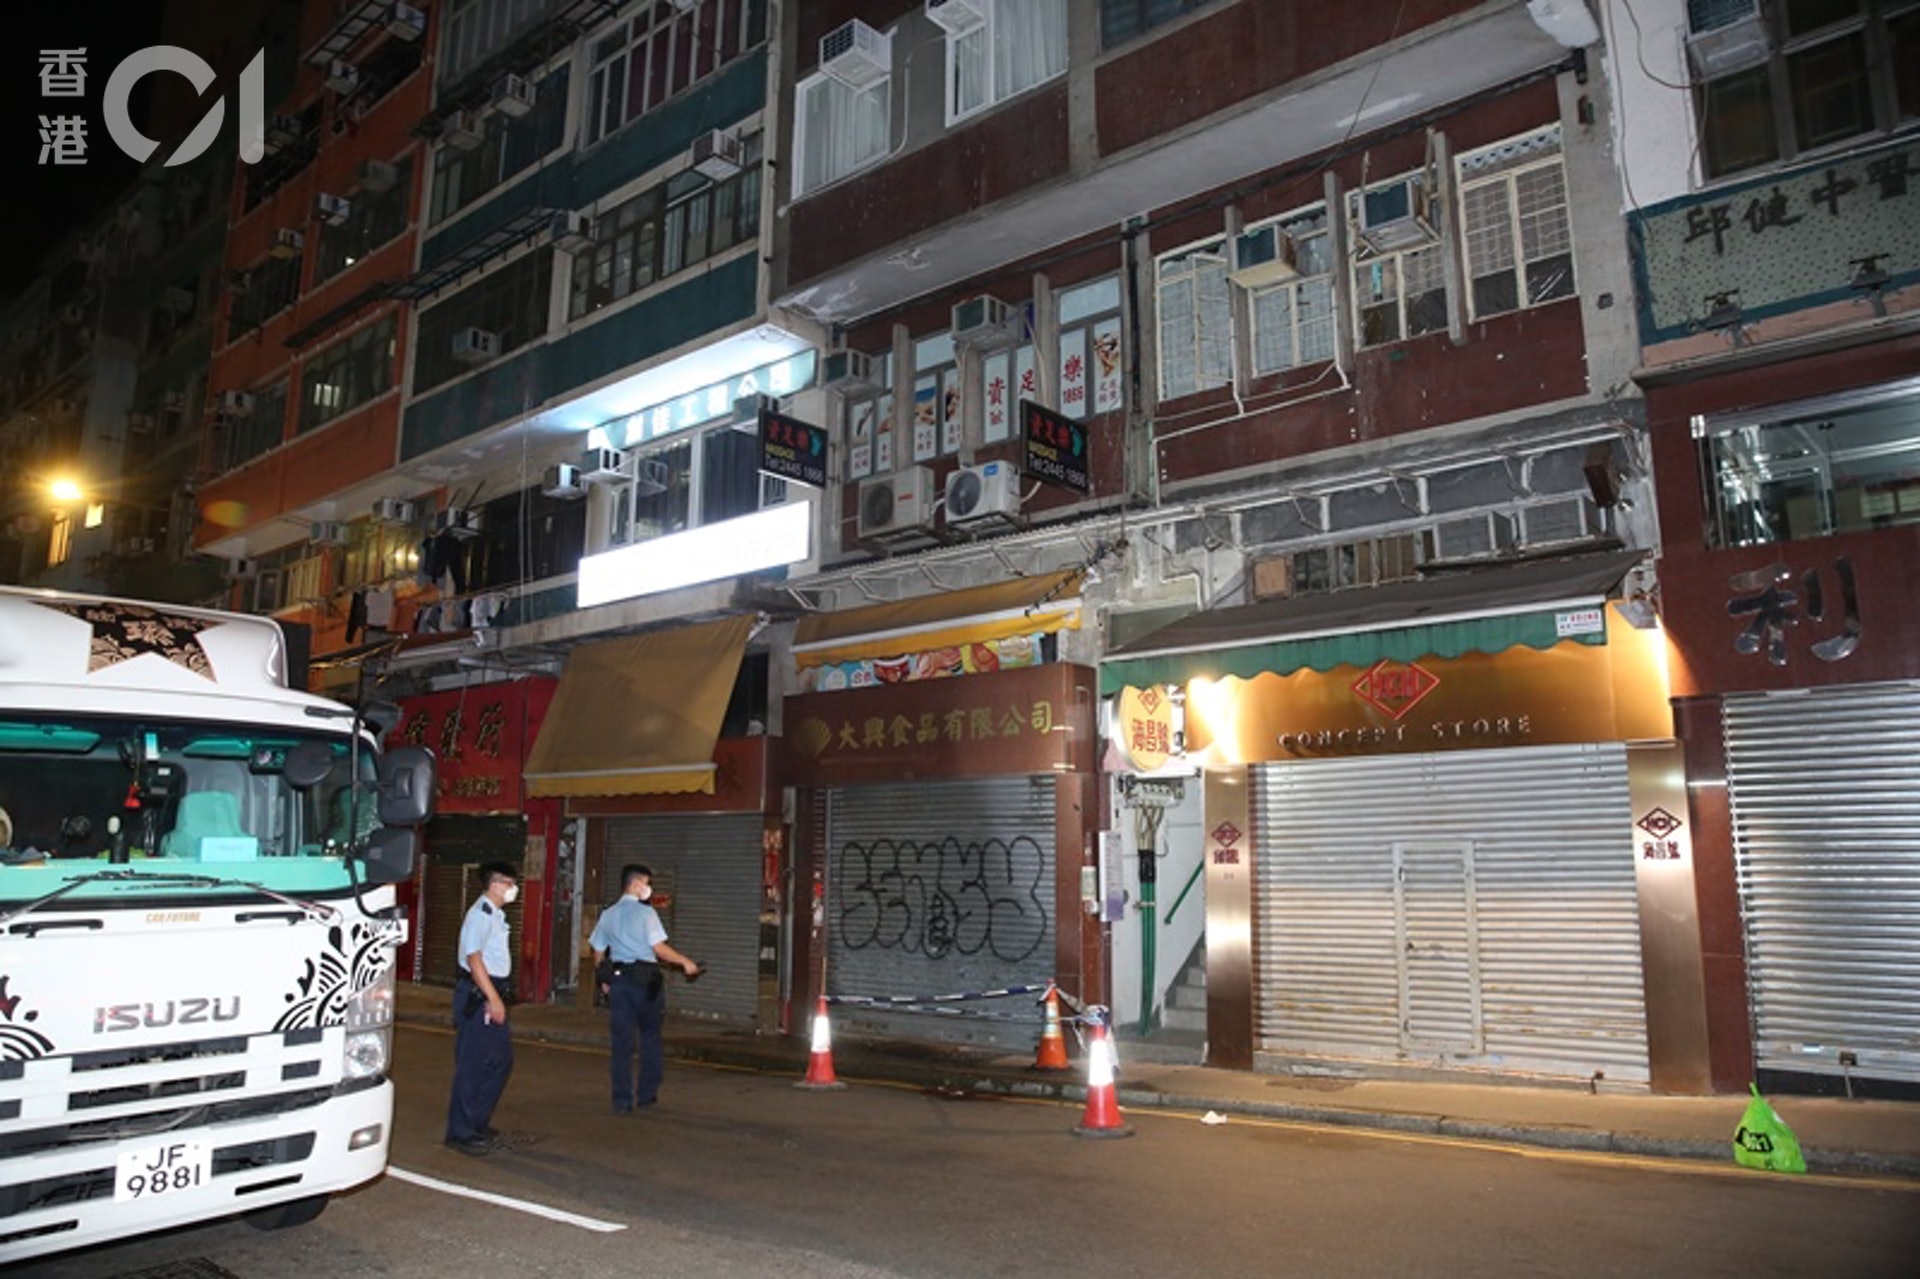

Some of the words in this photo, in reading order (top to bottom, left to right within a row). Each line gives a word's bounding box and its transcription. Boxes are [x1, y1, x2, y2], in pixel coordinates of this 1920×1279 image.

[1727, 552, 1862, 666] 利
[837, 699, 1051, 750] 大興食品有限公司
[1277, 724, 1407, 750] CONCEPT
[1432, 713, 1532, 739] STORE
[93, 995, 241, 1034] ISUZU
[146, 1143, 187, 1172] JF
[126, 1163, 201, 1198] 9881
